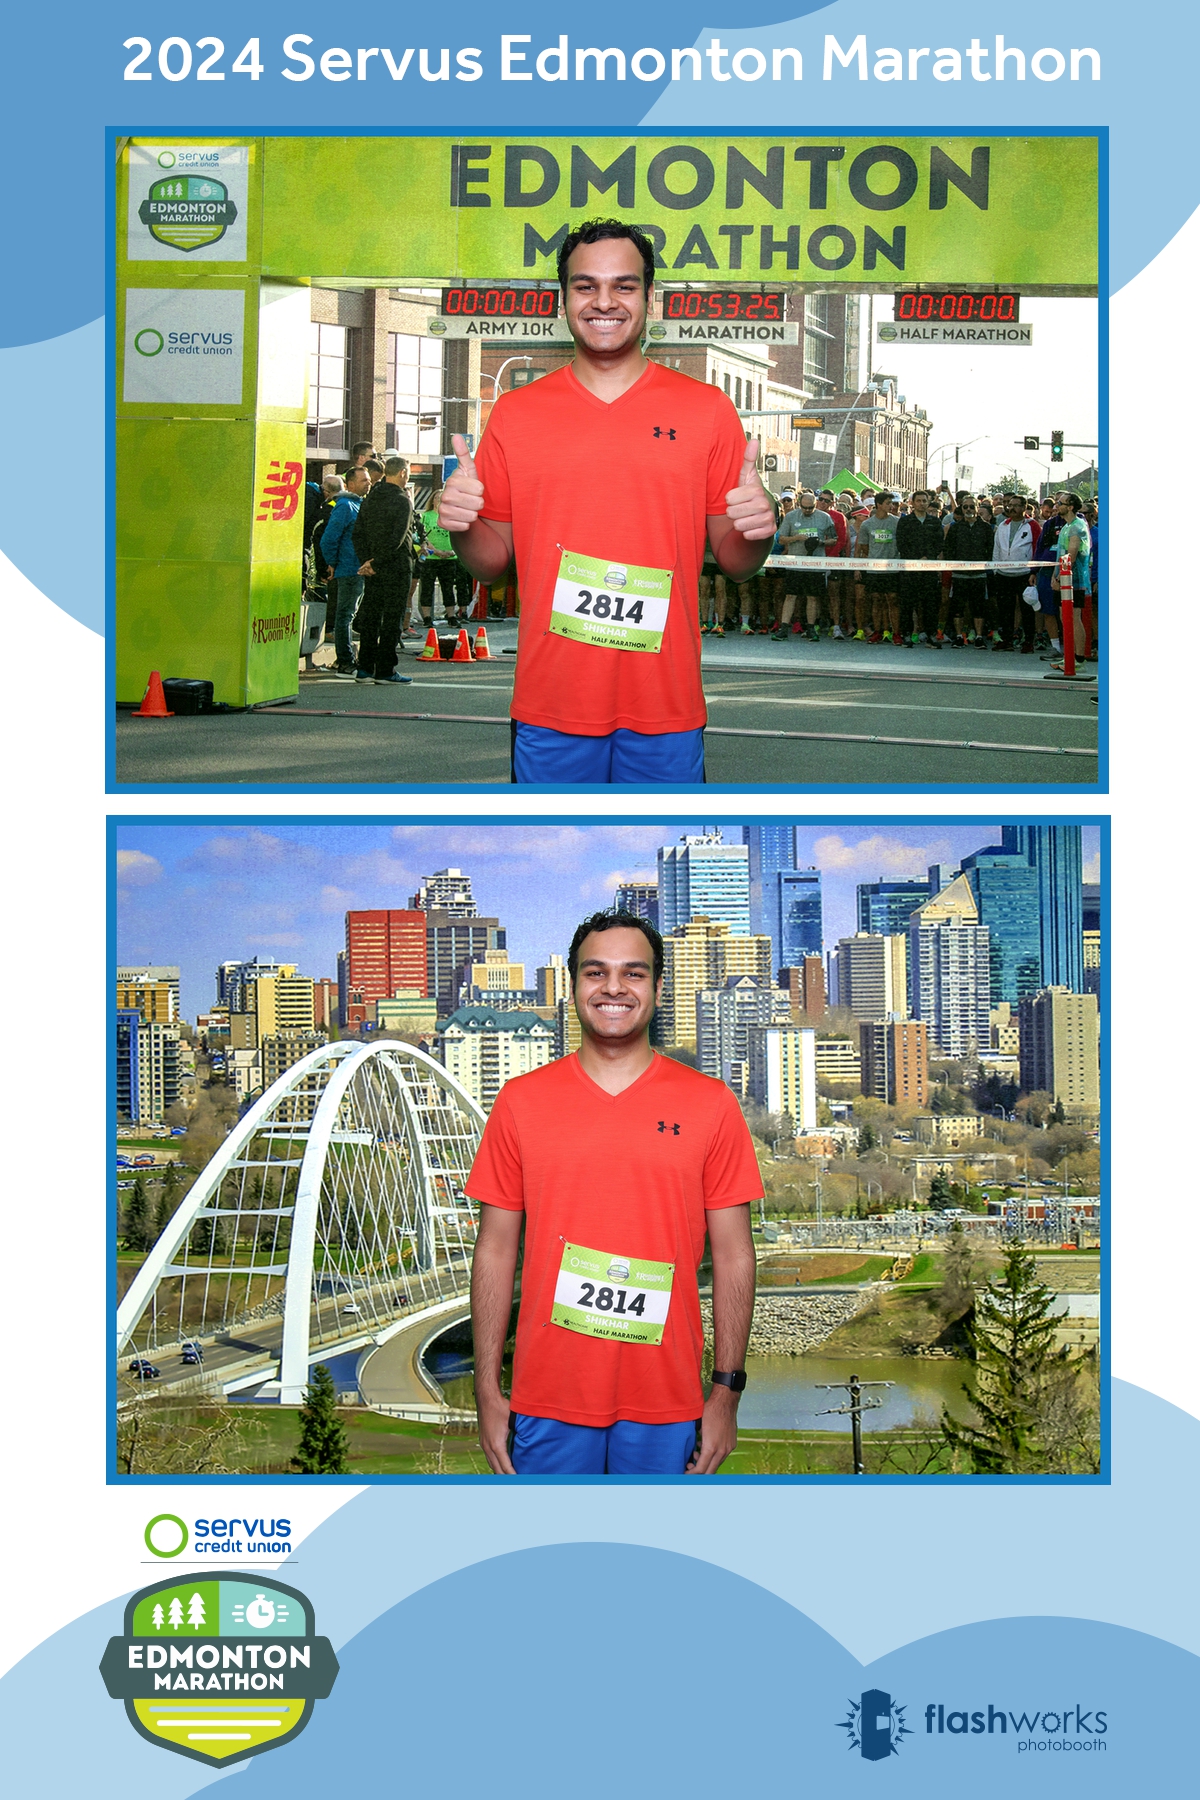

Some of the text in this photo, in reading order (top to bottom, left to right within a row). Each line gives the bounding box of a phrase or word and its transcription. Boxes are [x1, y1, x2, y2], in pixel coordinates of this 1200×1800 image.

[178, 152, 219, 161] servus
[450, 143, 991, 211] EDMONTON
[149, 202, 227, 213] EDMONTON
[160, 214, 215, 222] MARATHON
[523, 222, 907, 271] MRATHON
[466, 321, 554, 336] ARMY 10K
[679, 325, 785, 340] MARATHON
[901, 328, 939, 340] HALF
[943, 328, 1031, 340] MARATHON
[168, 332, 233, 345] servus
[168, 345, 233, 355] credit union
[575, 590, 645, 624] 2814
[583, 621, 628, 638] SHIKHAR
[591, 635, 608, 644] HALF
[609, 638, 647, 649] MARATHON
[577, 1282, 647, 1317] 2814
[585, 1314, 629, 1330] SHIKHAR
[593, 1328, 610, 1337] HALF
[611, 1330, 648, 1341] MARATHON
